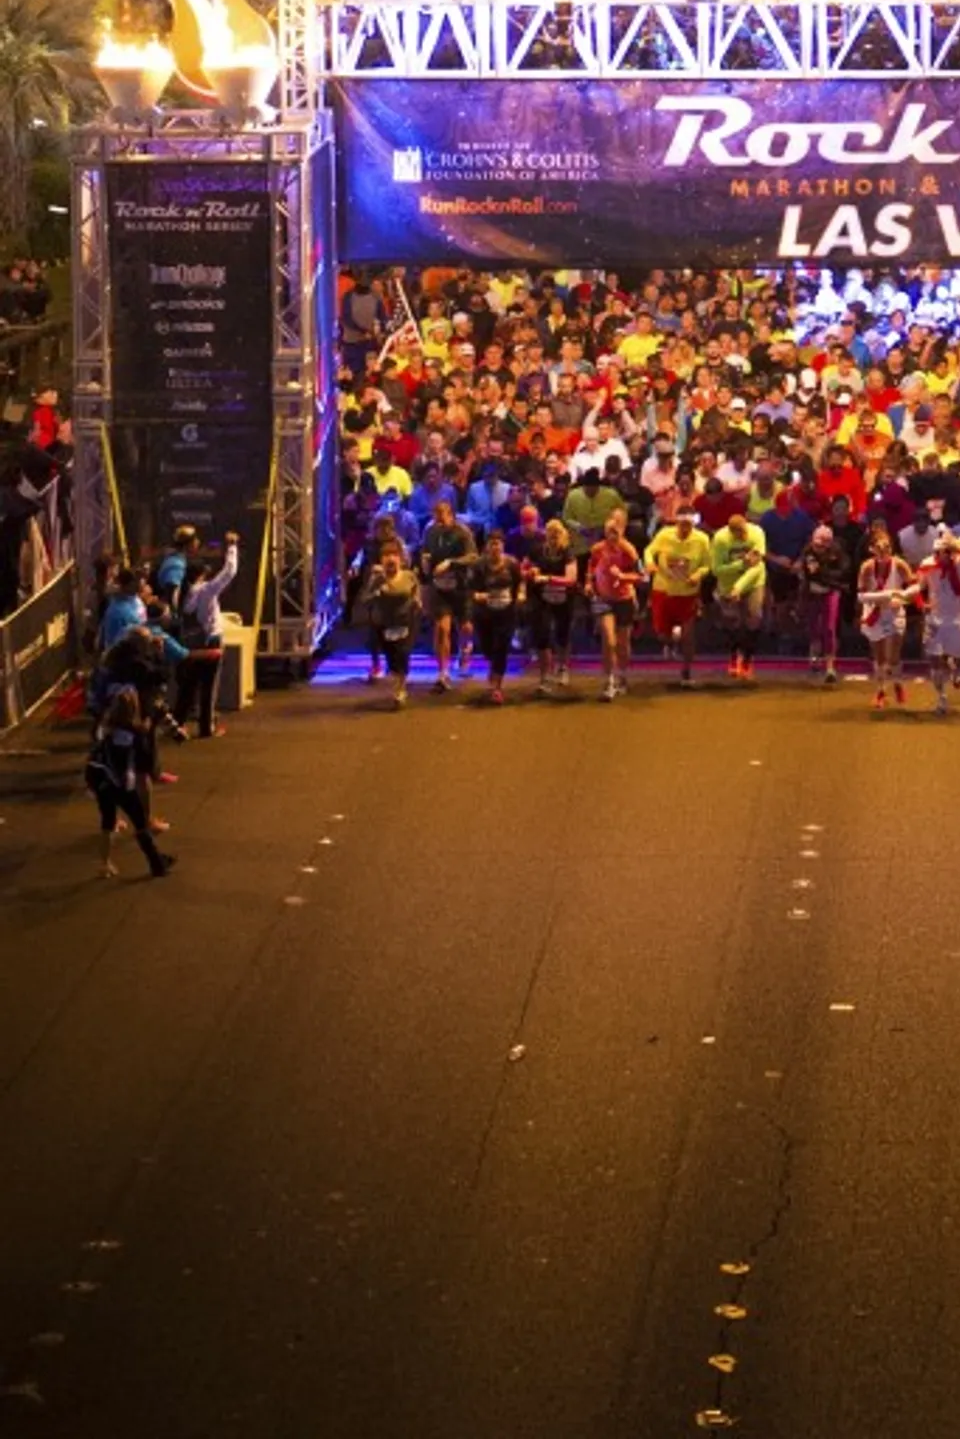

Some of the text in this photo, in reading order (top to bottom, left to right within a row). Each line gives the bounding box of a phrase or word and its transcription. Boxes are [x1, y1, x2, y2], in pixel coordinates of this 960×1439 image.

[527, 152, 601, 169] COLITIS
[425, 170, 601, 181] FOUNDATION OF AMERICA
[730, 178, 896, 198] MARATHON
[919, 175, 940, 196] &
[115, 201, 182, 218] Rock
[203, 201, 261, 218] Roll
[124, 221, 200, 232] MARATHON
[778, 203, 914, 258] LAS
